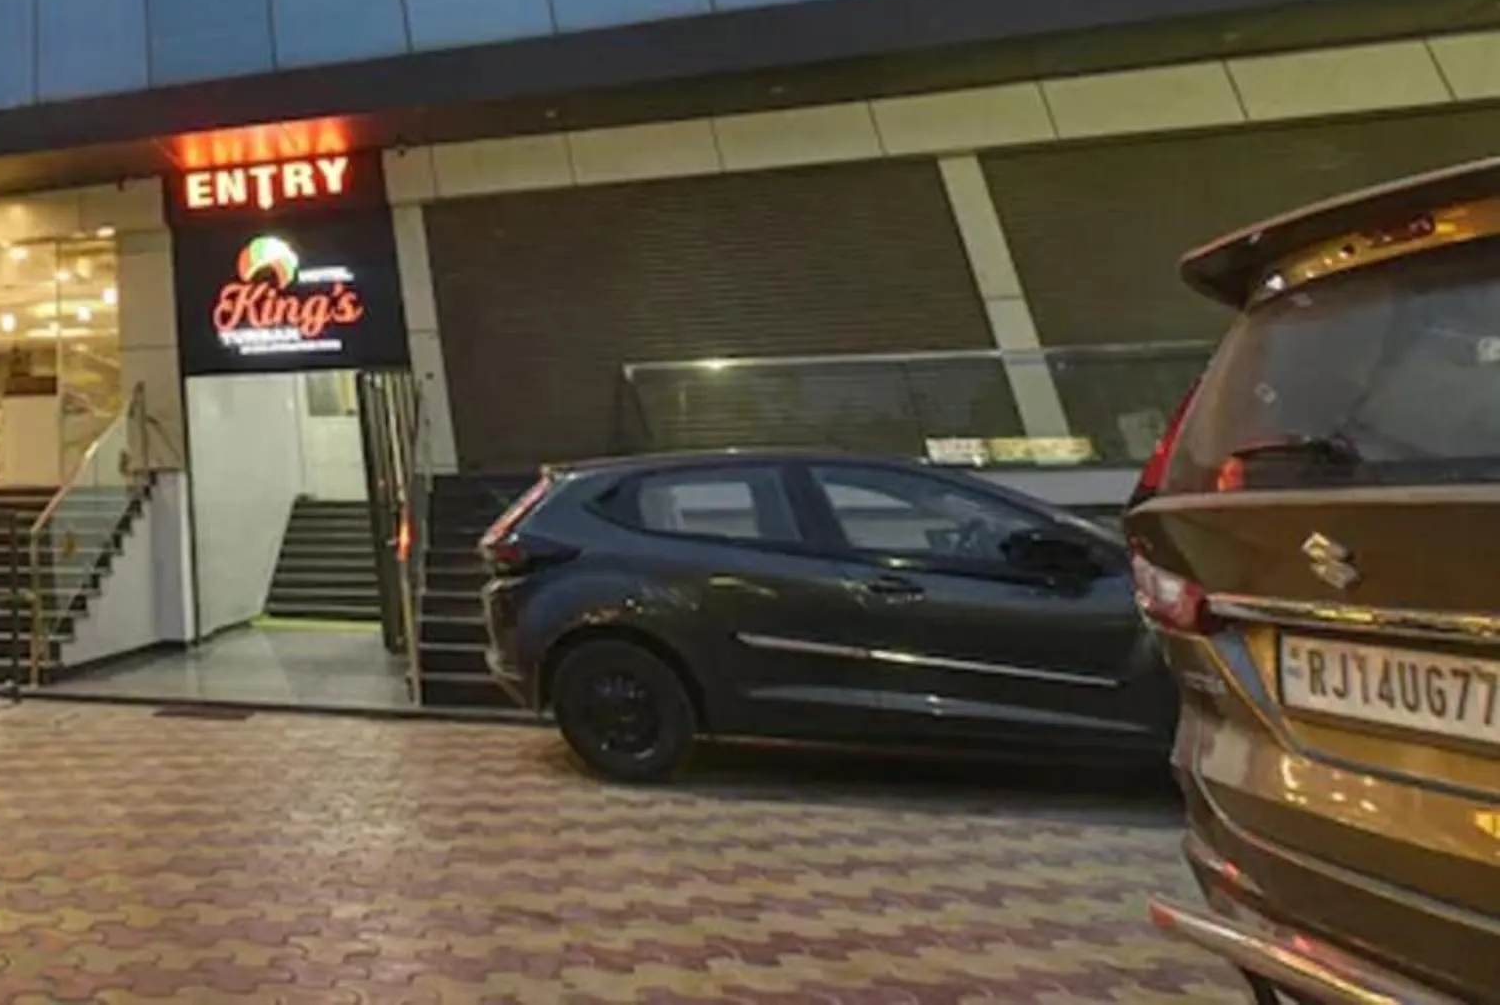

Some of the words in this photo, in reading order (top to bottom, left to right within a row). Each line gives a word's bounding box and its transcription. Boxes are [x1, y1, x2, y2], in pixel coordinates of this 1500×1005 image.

[185, 156, 350, 211] ENTRY
[212, 281, 365, 339] King's
[1307, 648, 1498, 727] RJ14UG77
